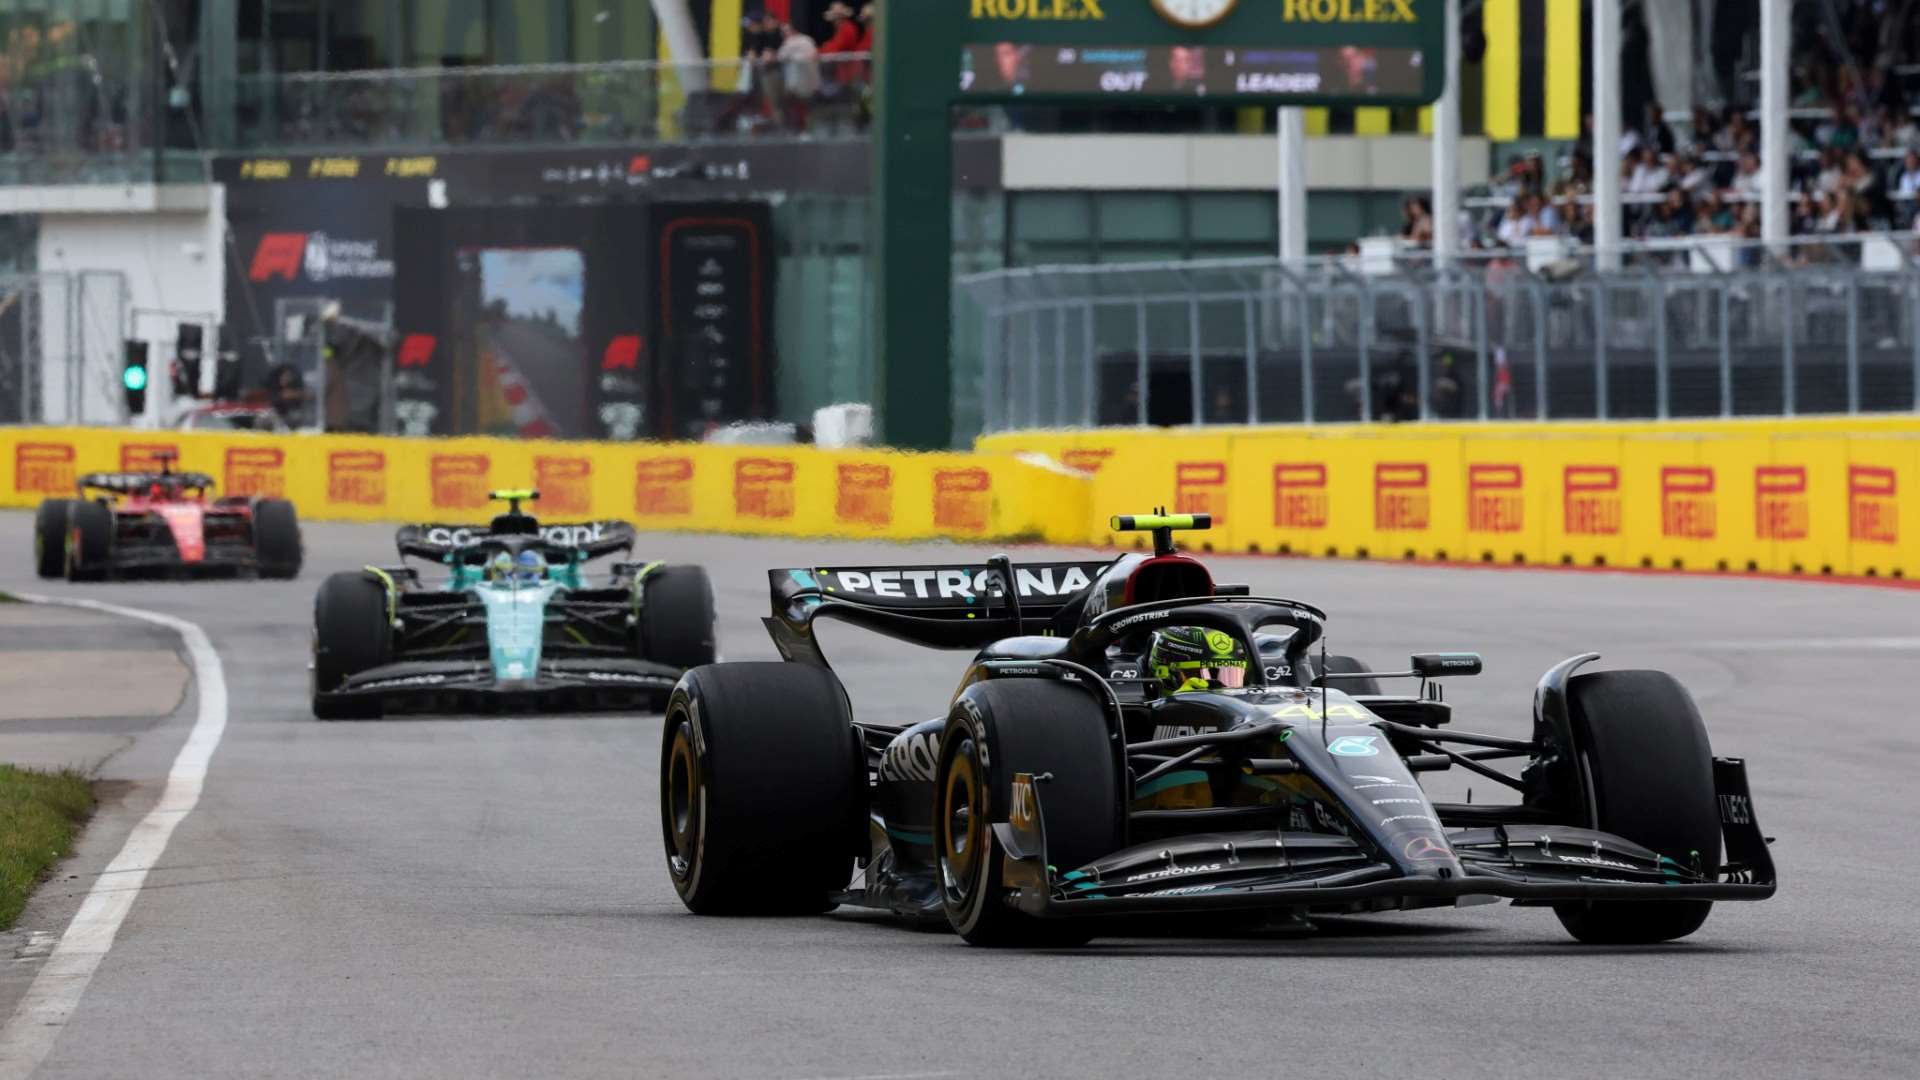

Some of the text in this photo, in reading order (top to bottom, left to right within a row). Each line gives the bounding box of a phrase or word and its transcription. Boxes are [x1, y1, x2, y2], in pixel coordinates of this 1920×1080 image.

[971, 0, 1105, 19] ROLEX
[1283, 0, 1416, 22] ROLEX
[1100, 70, 1147, 92] OUT
[1236, 72, 1320, 92] LEADER
[837, 564, 1110, 598] PETRNA
[1126, 863, 1222, 882] PETRONAS
